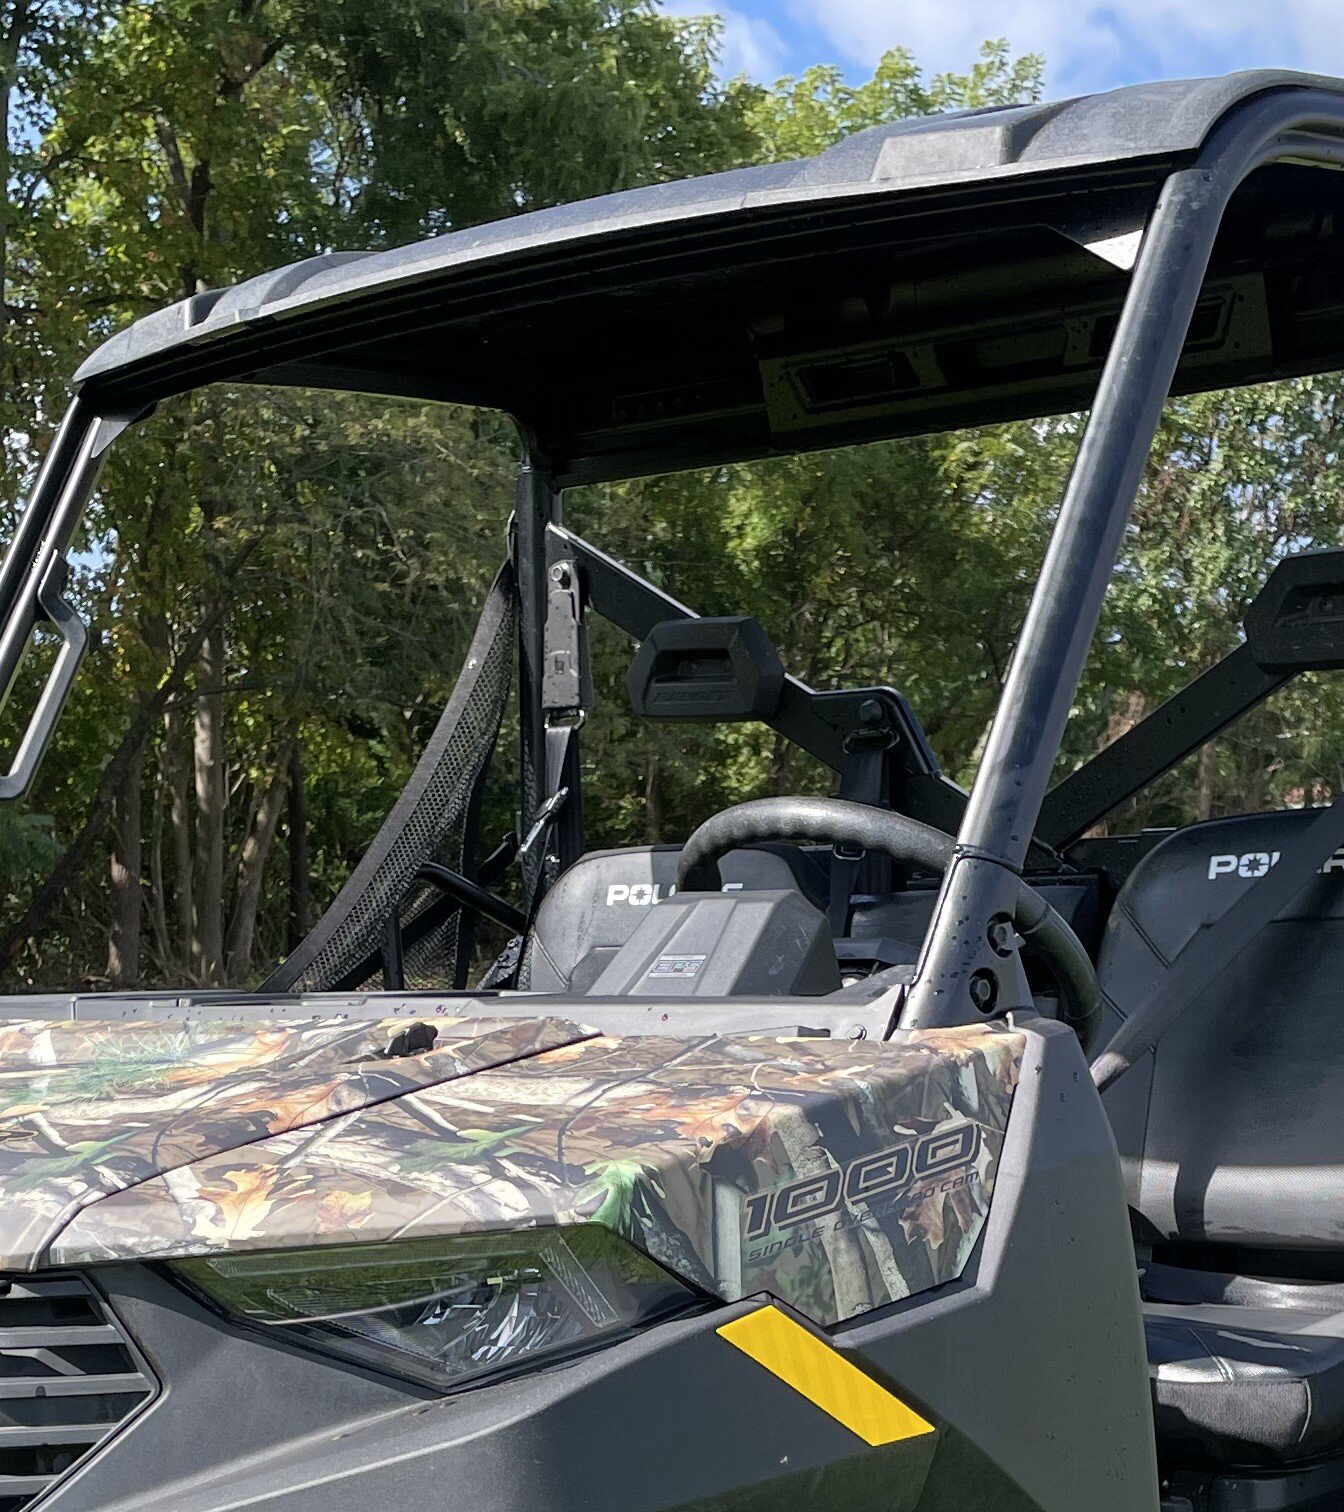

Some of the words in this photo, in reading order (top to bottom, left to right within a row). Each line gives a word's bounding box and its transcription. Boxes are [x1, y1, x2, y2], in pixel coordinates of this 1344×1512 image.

[743, 1122, 982, 1242] 1000
[748, 1225, 824, 1262] SINGLE
[940, 1171, 979, 1193] CAM
